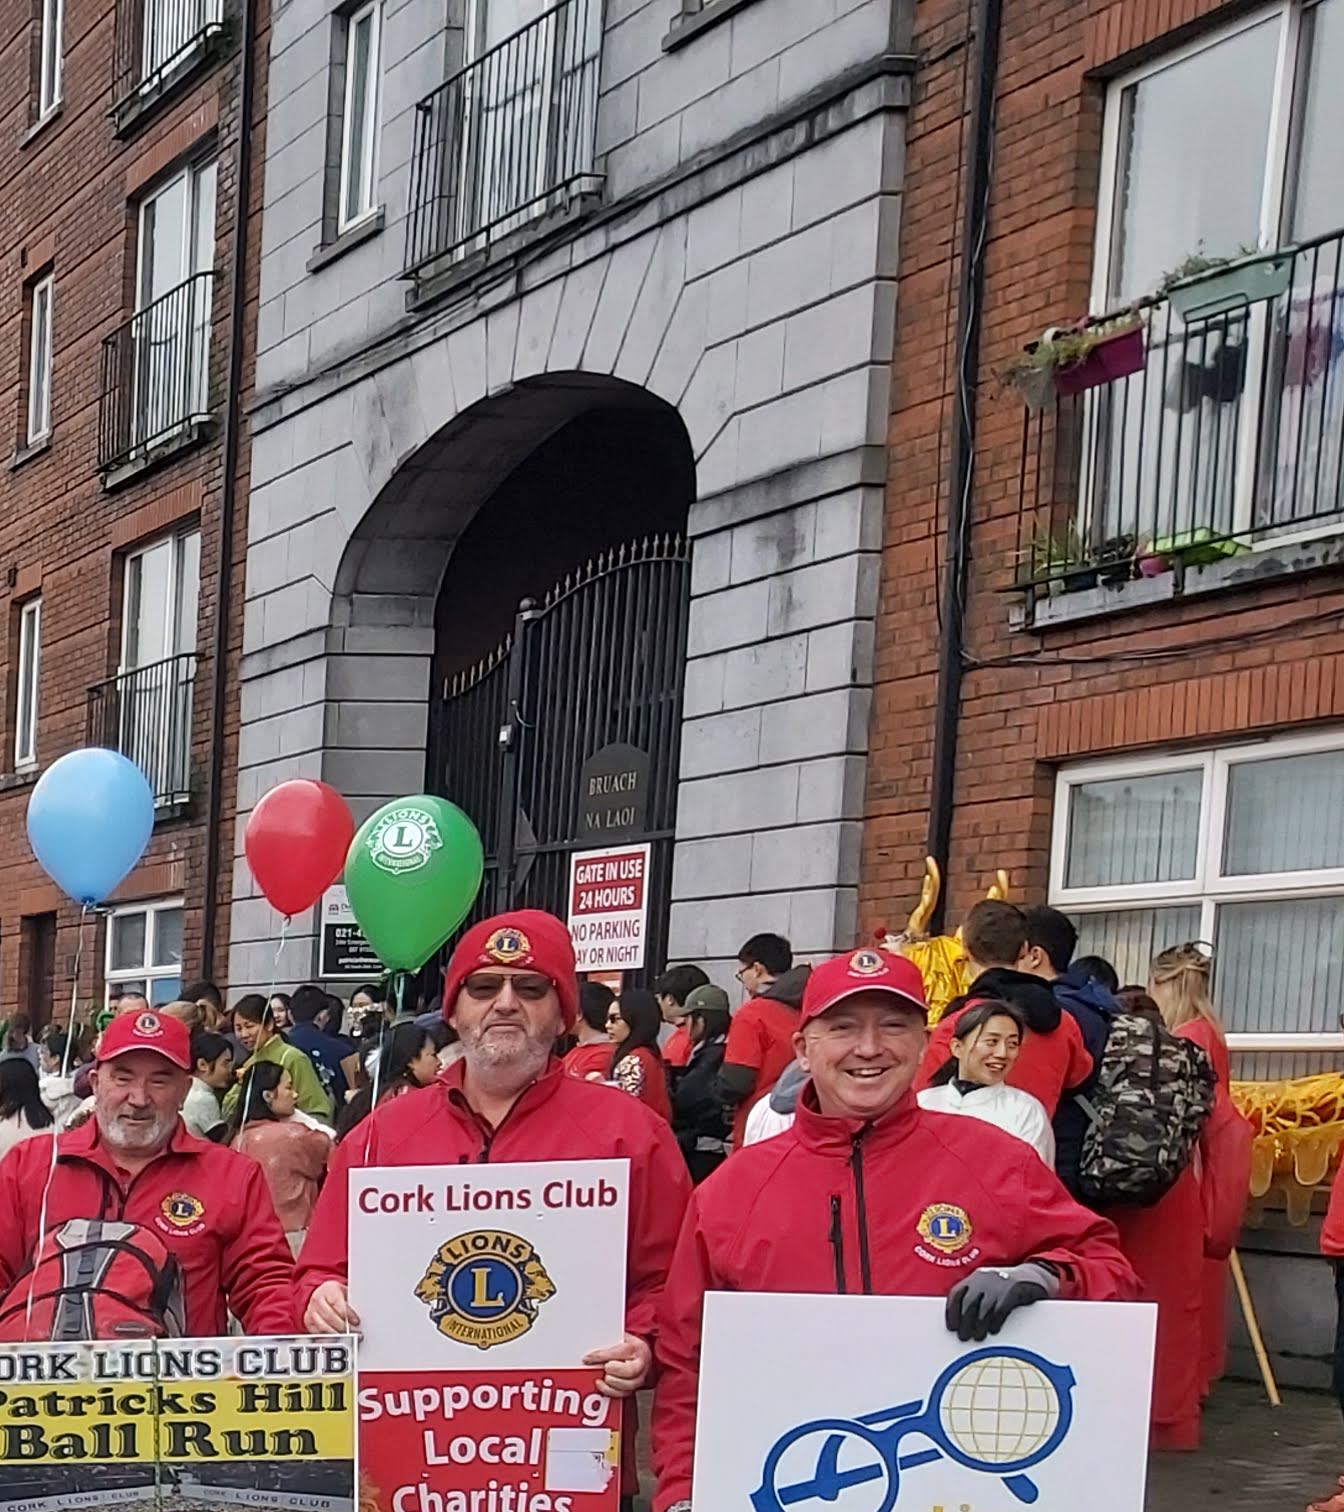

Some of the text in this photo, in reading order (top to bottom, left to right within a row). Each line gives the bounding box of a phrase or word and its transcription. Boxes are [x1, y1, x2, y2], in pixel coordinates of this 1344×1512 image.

[589, 772, 637, 796] BRUACH
[381, 810, 428, 827] LIONS
[585, 807, 634, 829] NA LAOI
[576, 859, 642, 885] GATE IN USE
[578, 886, 634, 910] 24 HOURS
[572, 918, 640, 941] NO PARKING
[574, 945, 639, 964] AY OR NIGHT
[359, 1179, 618, 1213] Cork Lions Club
[446, 1235, 527, 1262] LIONS
[470, 1268, 504, 1307] L
[446, 1318, 524, 1341] INTERNATIONAL
[95, 1348, 220, 1378] LIONS
[237, 1346, 348, 1375] CLUB
[237, 1382, 347, 1412] Hill
[360, 1379, 610, 1426] Supporting
[0, 1421, 317, 1459] Ball Run
[424, 1427, 542, 1466] Local
[6, 1500, 47, 1512] CORK
[289, 1497, 331, 1509] CLUB
